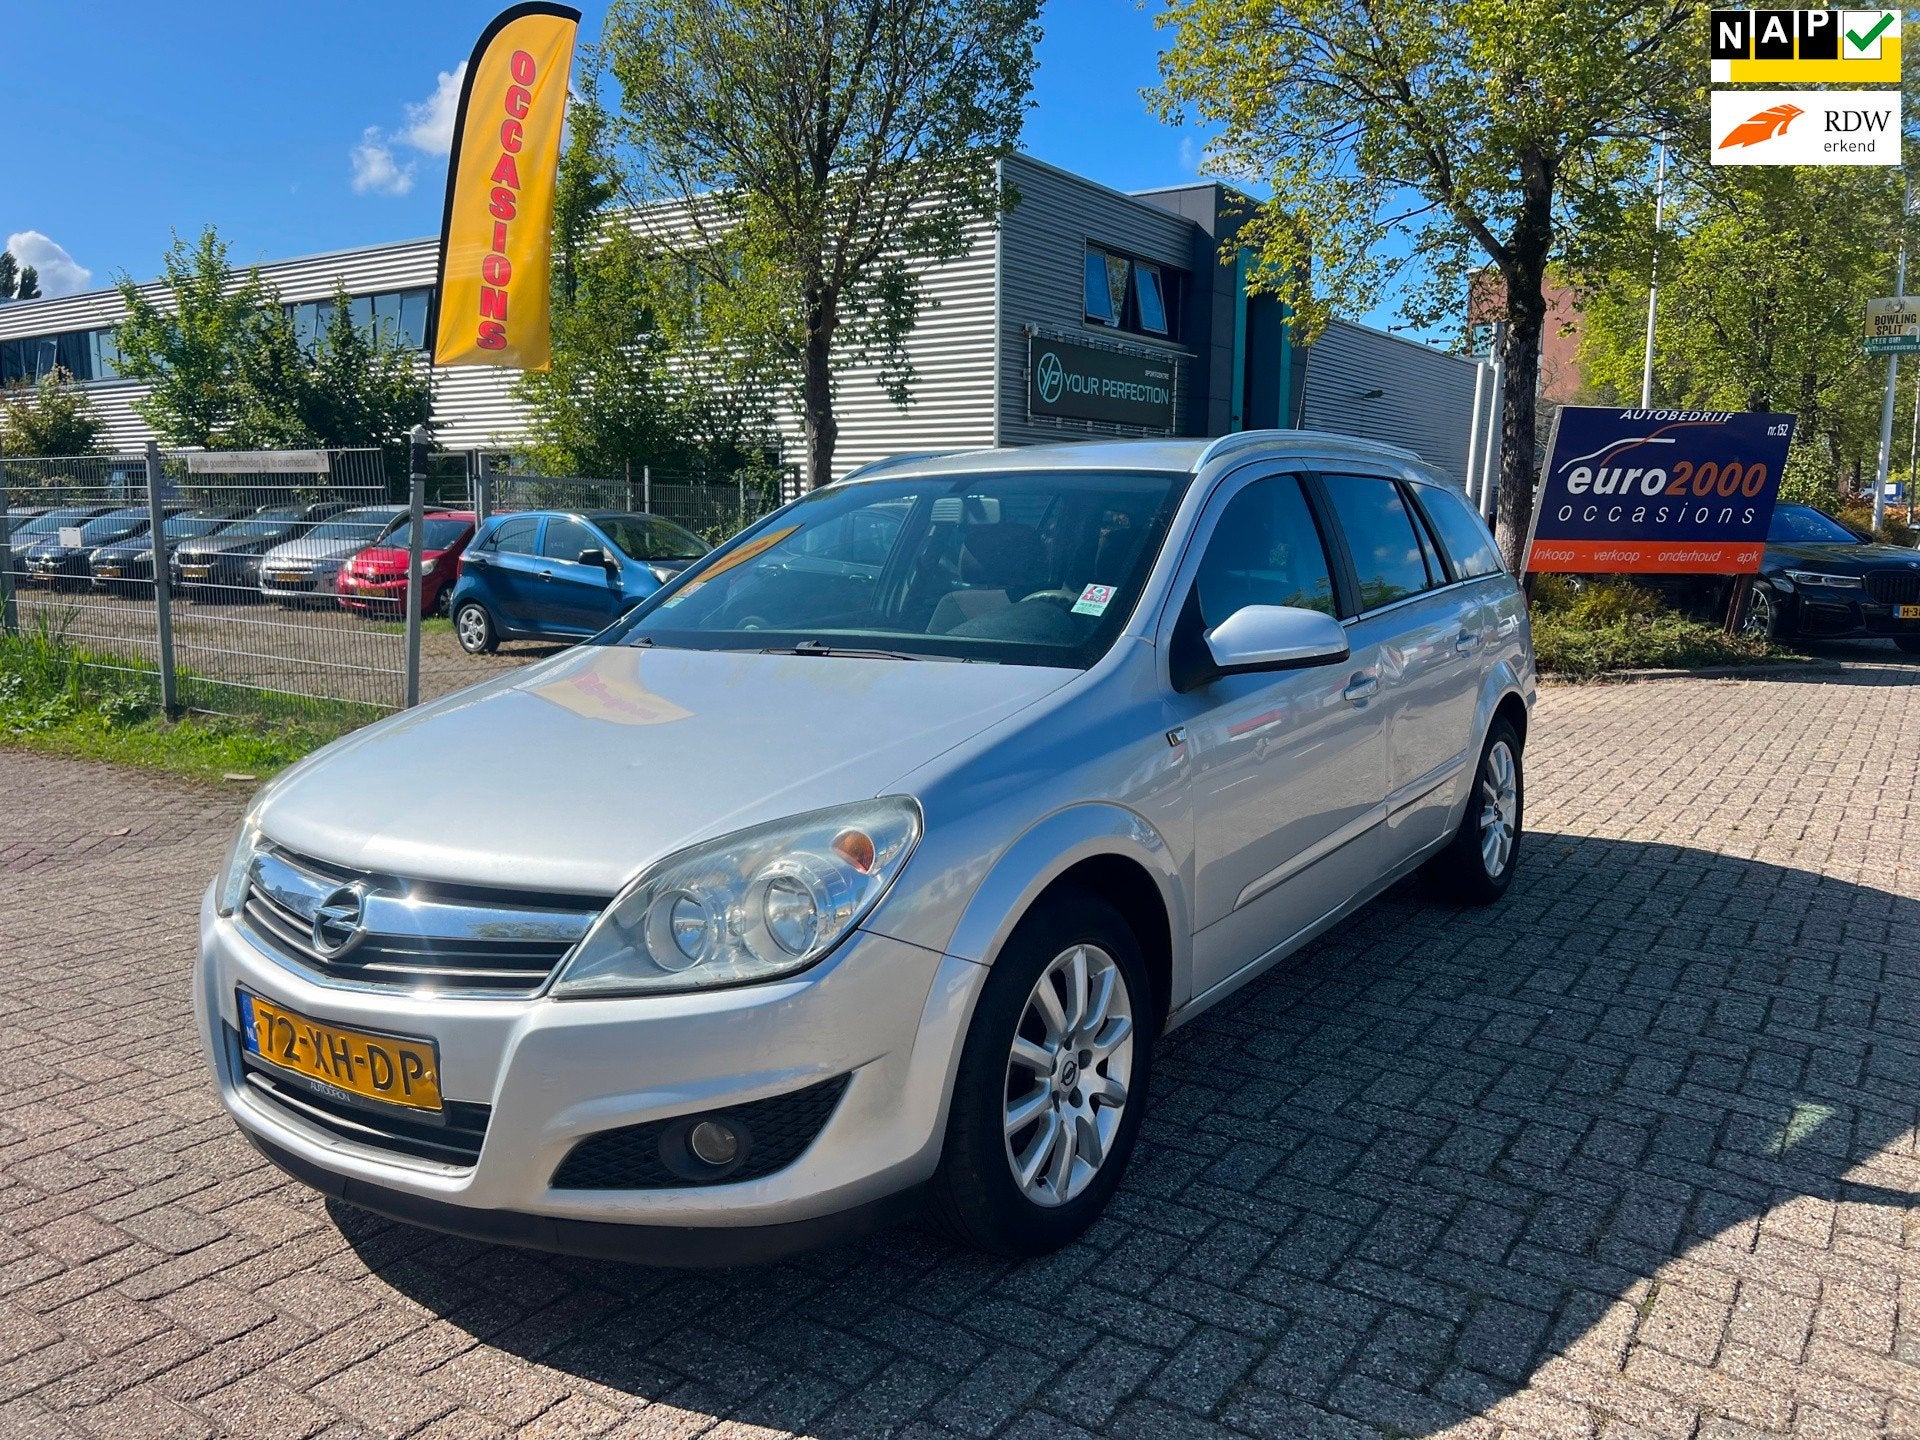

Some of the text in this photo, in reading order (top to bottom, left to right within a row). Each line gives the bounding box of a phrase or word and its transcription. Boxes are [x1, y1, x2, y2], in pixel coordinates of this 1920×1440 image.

[476, 50, 536, 350] OCCASIONS
[1874, 314, 1917, 326] BOWLING
[1876, 324, 1903, 336] SPLIT
[1064, 373, 1169, 405] YOUR PERFECTION
[1620, 409, 1735, 422] AUTOBEDRIJF
[1767, 424, 1789, 436] nr.152
[1567, 460, 1768, 498] euro2000
[1558, 502, 1755, 524] occasions
[1533, 549, 1758, 564] Inkoop verkoop onderhoud apk
[1902, 607, 1920, 617] H-3
[259, 1008, 424, 1096] 72-XH-DP
